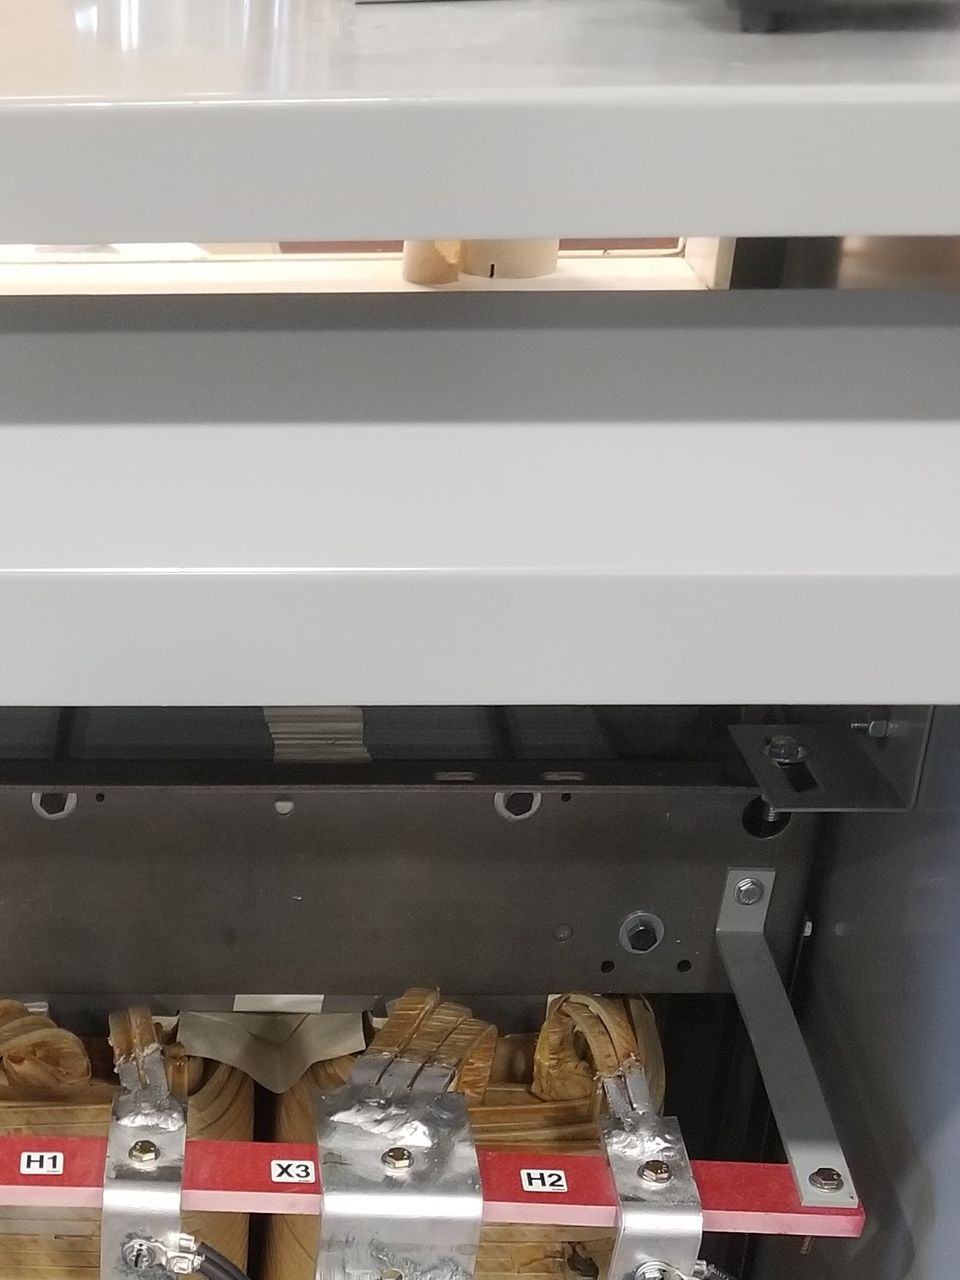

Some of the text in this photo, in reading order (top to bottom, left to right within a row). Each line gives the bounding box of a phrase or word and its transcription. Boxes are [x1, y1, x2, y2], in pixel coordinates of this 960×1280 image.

[26, 1154, 59, 1169] H1
[275, 1163, 311, 1179] X3
[526, 1172, 565, 1188] H2
